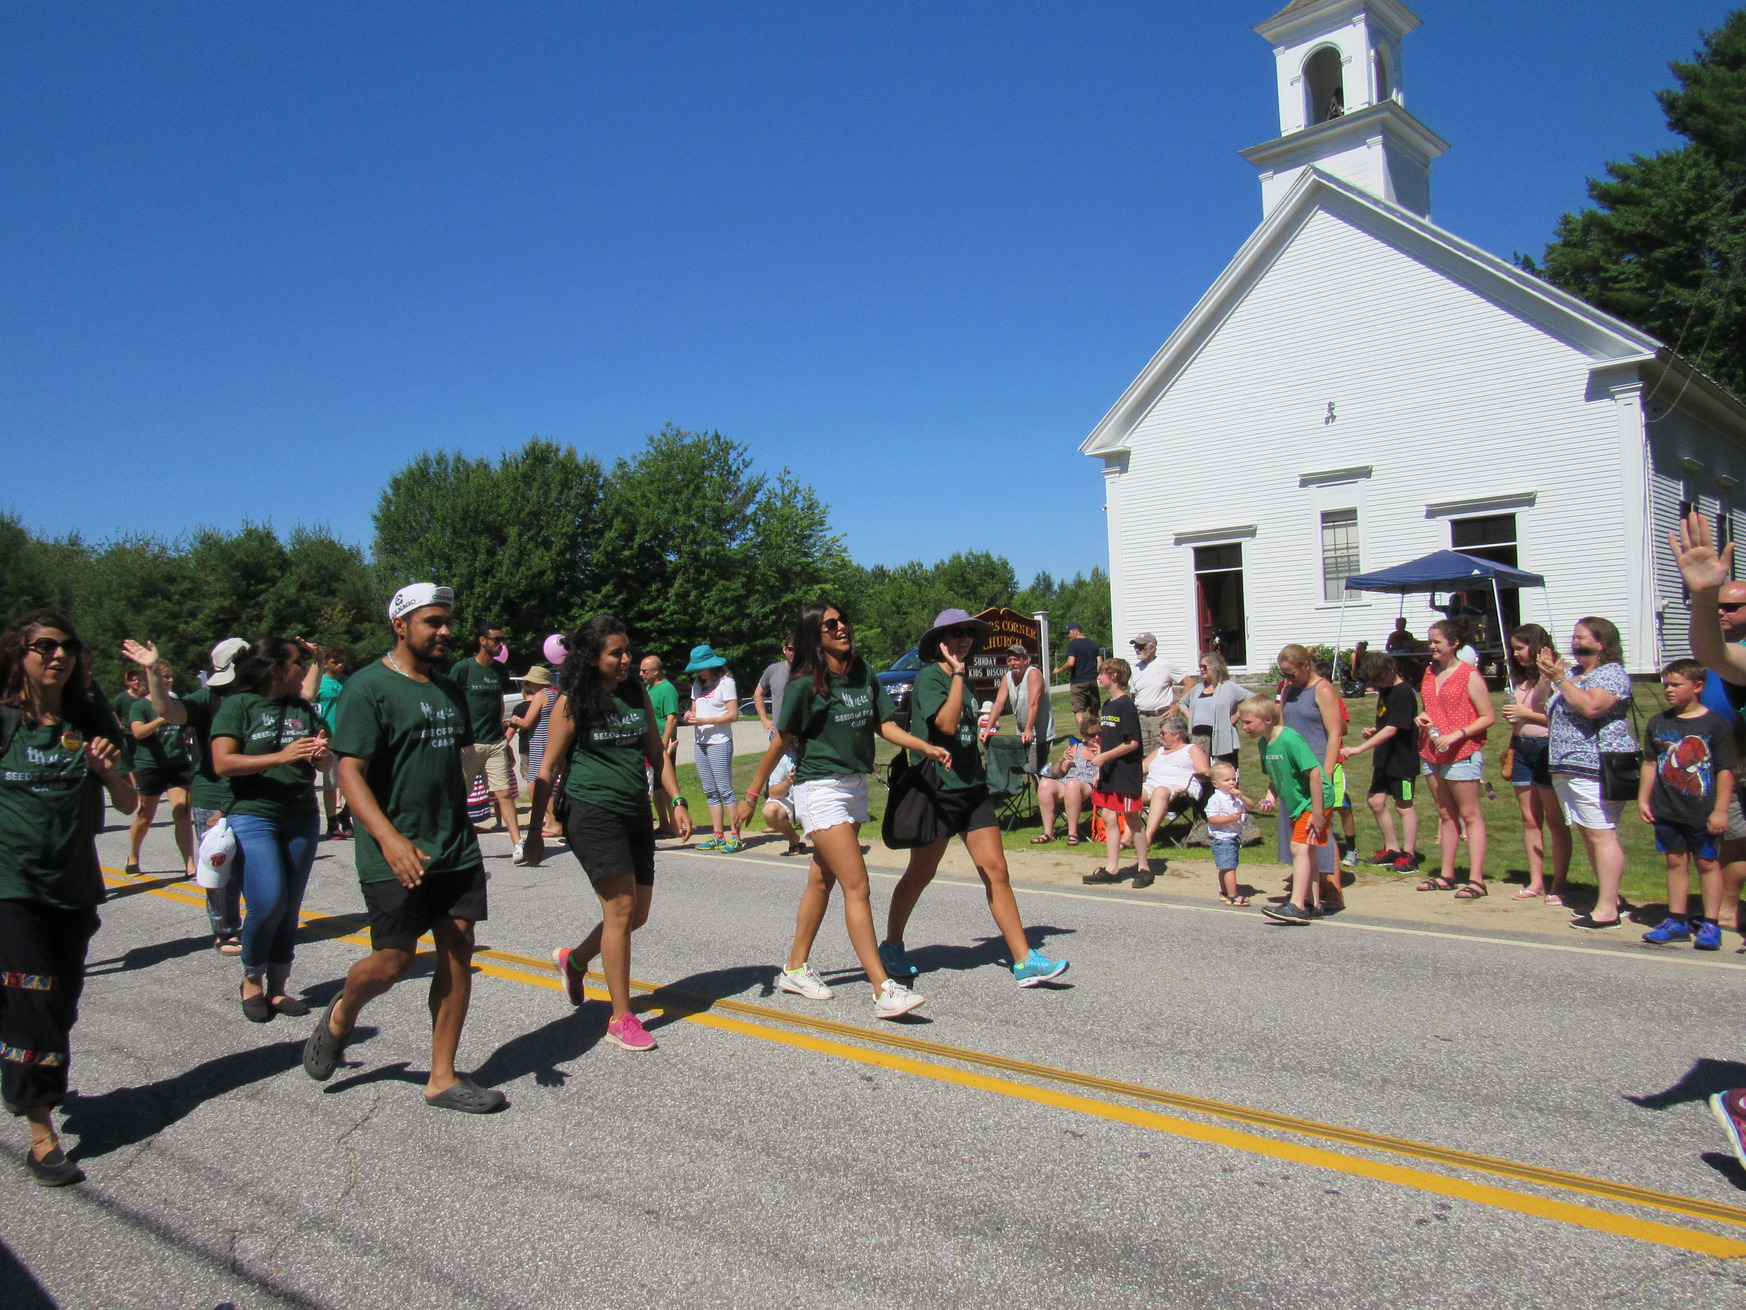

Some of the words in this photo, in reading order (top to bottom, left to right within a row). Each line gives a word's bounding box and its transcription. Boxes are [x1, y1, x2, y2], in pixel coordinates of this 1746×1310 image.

[1002, 620, 1037, 640] CORNER
[973, 656, 997, 666] SUNDAY
[968, 668, 983, 678] KIDS
[835, 713, 854, 722] SEEDS
[435, 728, 448, 737] OF
[593, 731, 620, 741] SEEDS
[431, 737, 455, 748] CAMP
[5, 771, 40, 780] SEEDS
[60, 768, 88, 780] PEAC
